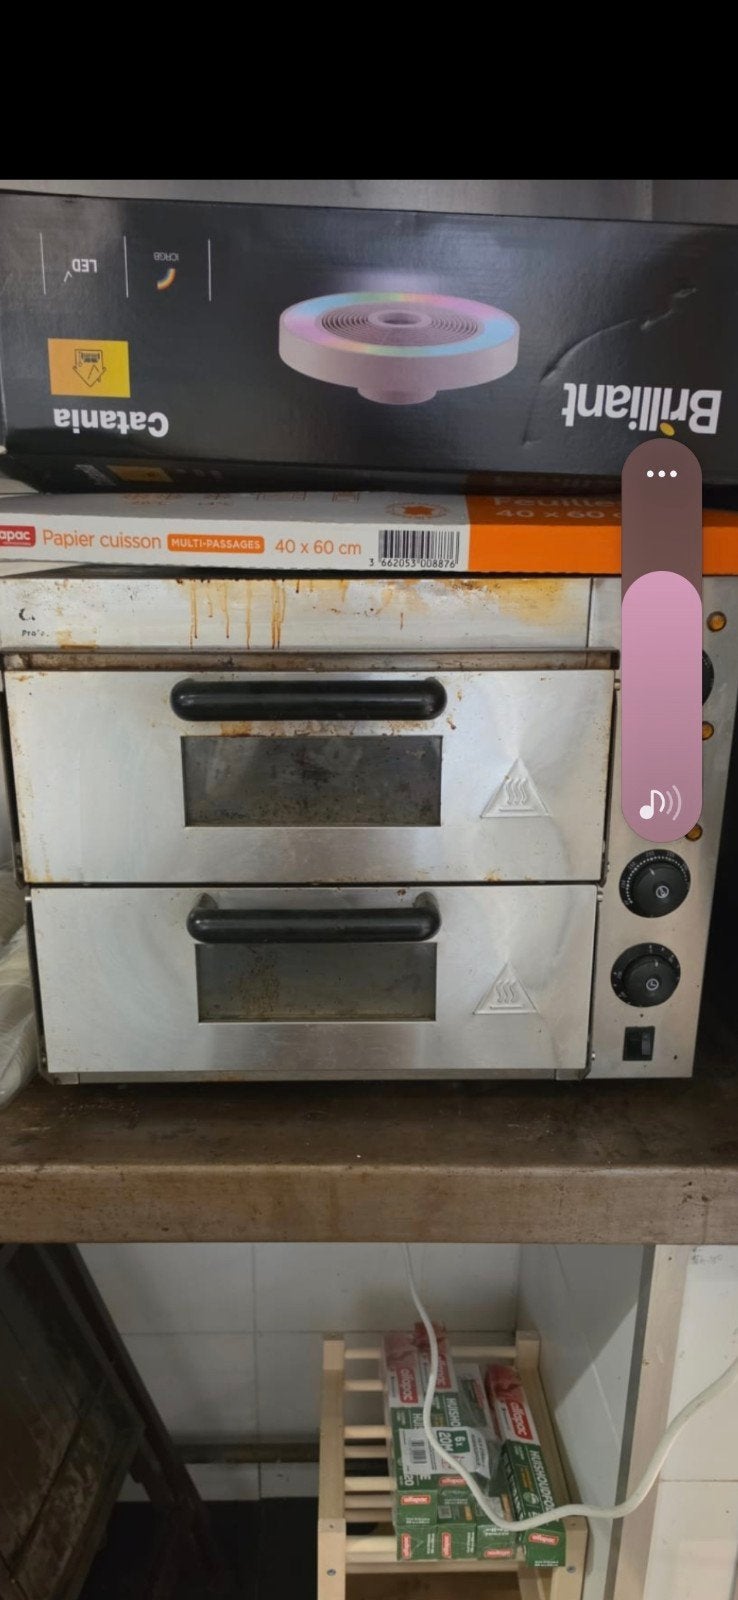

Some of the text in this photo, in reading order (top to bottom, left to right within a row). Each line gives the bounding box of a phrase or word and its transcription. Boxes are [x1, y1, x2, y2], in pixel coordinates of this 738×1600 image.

[71, 258, 98, 273] LED
[561, 383, 723, 436] Brilliant
[52, 408, 169, 438] Catania
[492, 496, 615, 508] Feuille
[495, 509, 534, 518] 40
[566, 510, 605, 519] 60
[43, 529, 162, 549] Papier cuisson
[171, 538, 261, 549] MULTI-PASSAGES
[275, 539, 362, 555] 40 x 60 cm
[369, 558, 456, 569] 3 662053 008876
[400, 1368, 415, 1401] alfapac
[510, 1402, 529, 1437] alfapac
[454, 1435, 466, 1447] 6x
